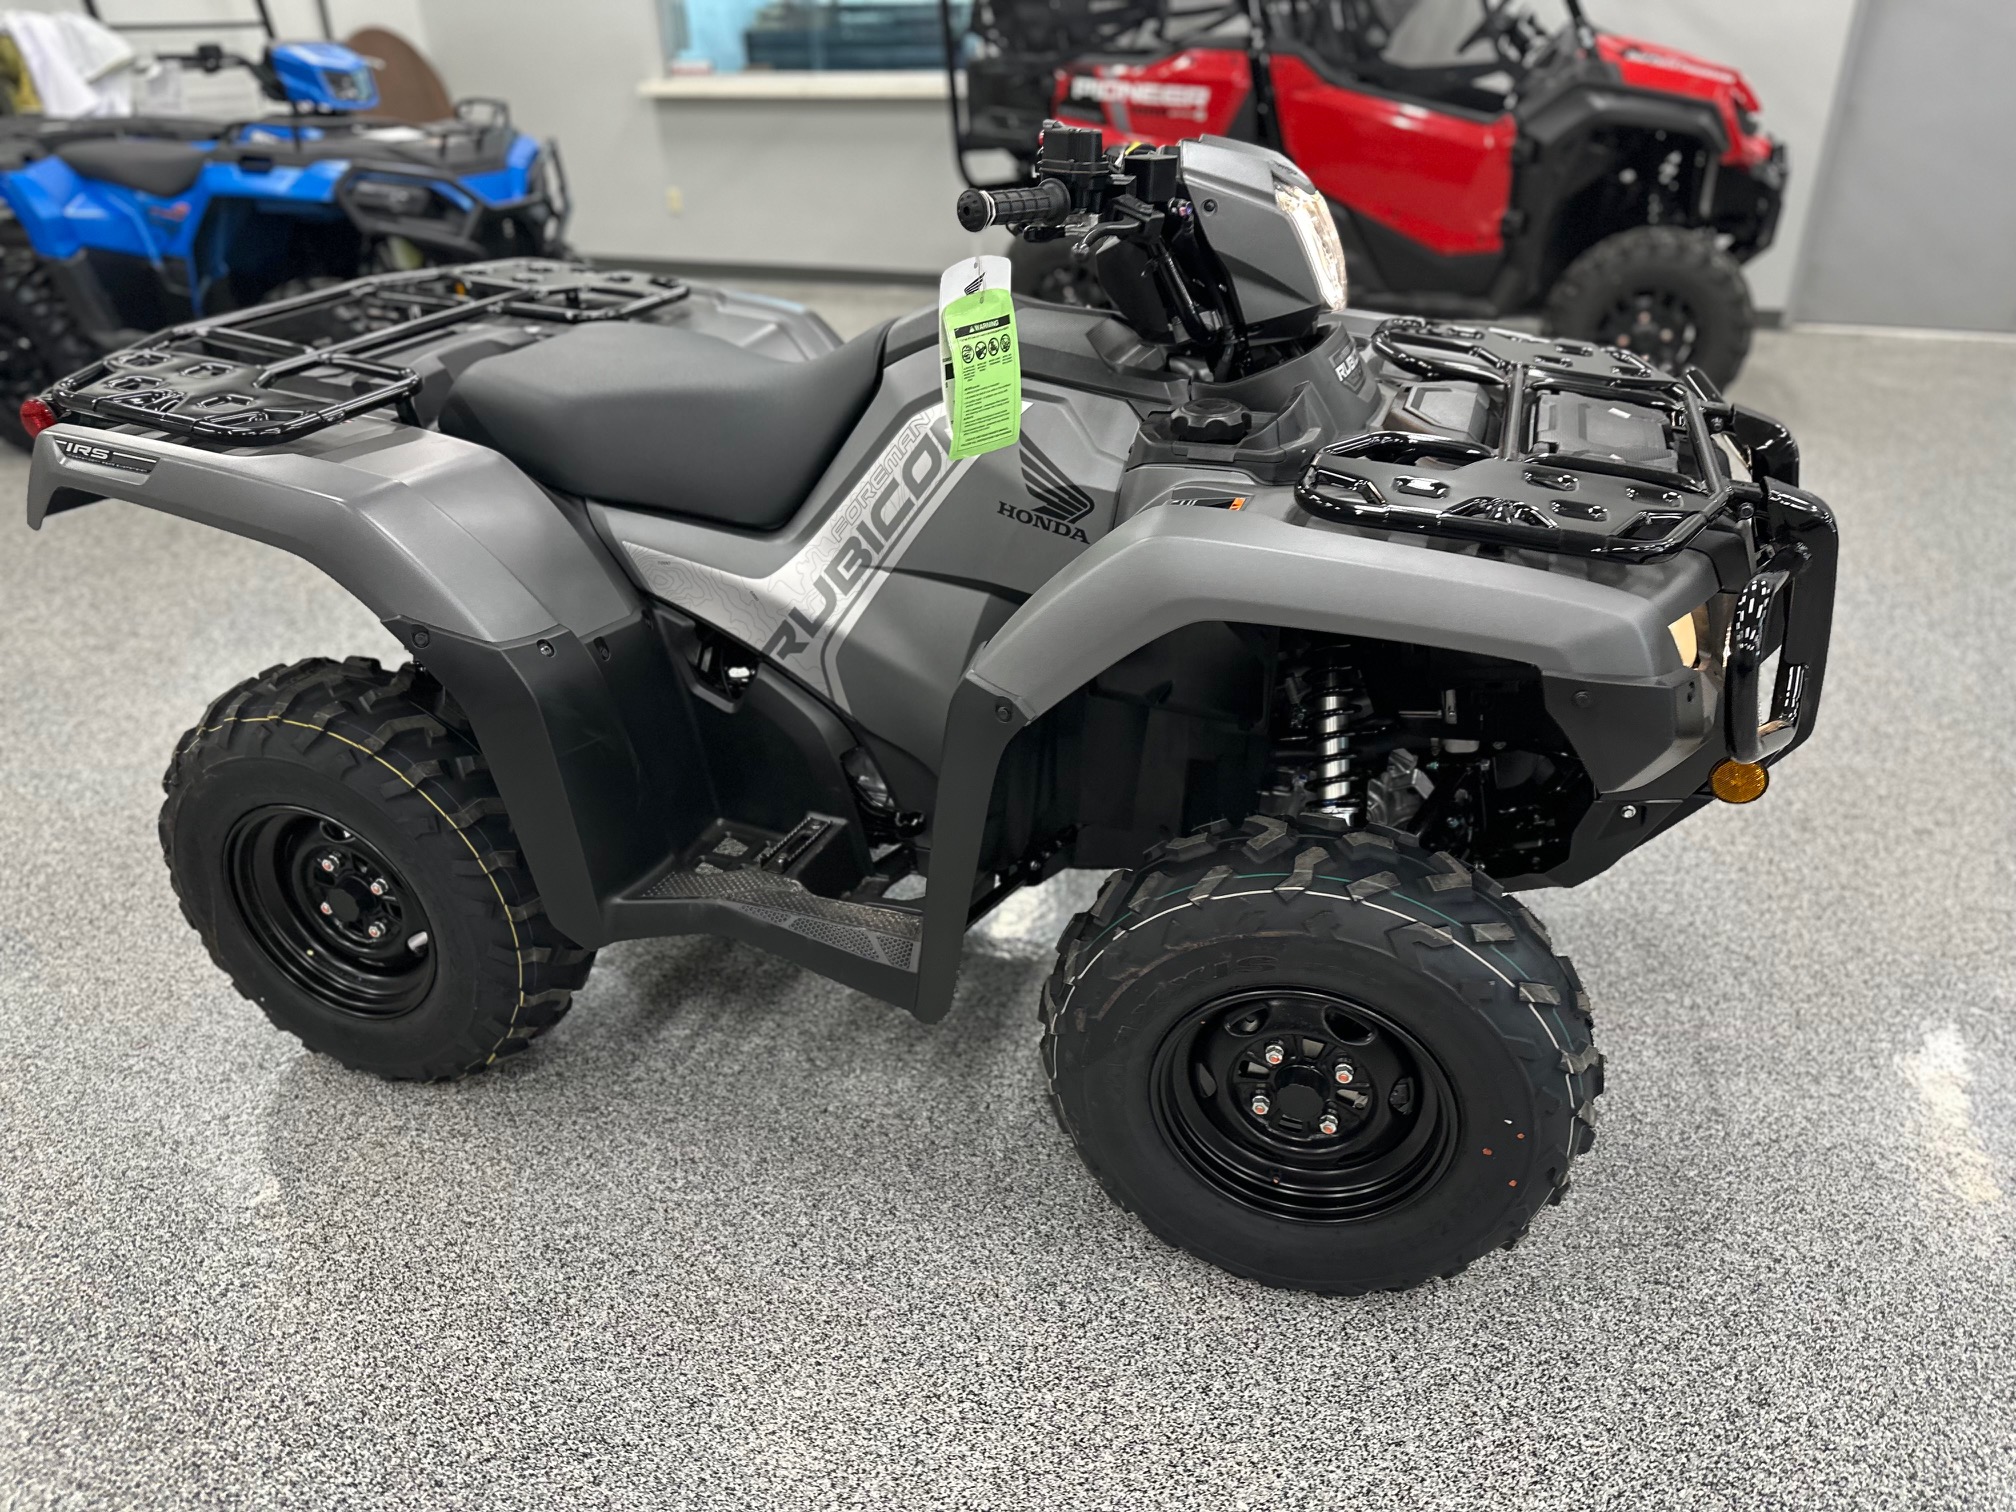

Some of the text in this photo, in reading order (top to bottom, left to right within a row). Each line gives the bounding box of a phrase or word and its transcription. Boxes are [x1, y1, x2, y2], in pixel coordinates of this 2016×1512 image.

[1070, 76, 1211, 108] PIONEER
[974, 319, 1000, 332] WARNING
[1335, 346, 1360, 382] RUB
[66, 442, 110, 460] IRS
[831, 410, 931, 543] FOREMAN
[997, 500, 1091, 545] HONDA
